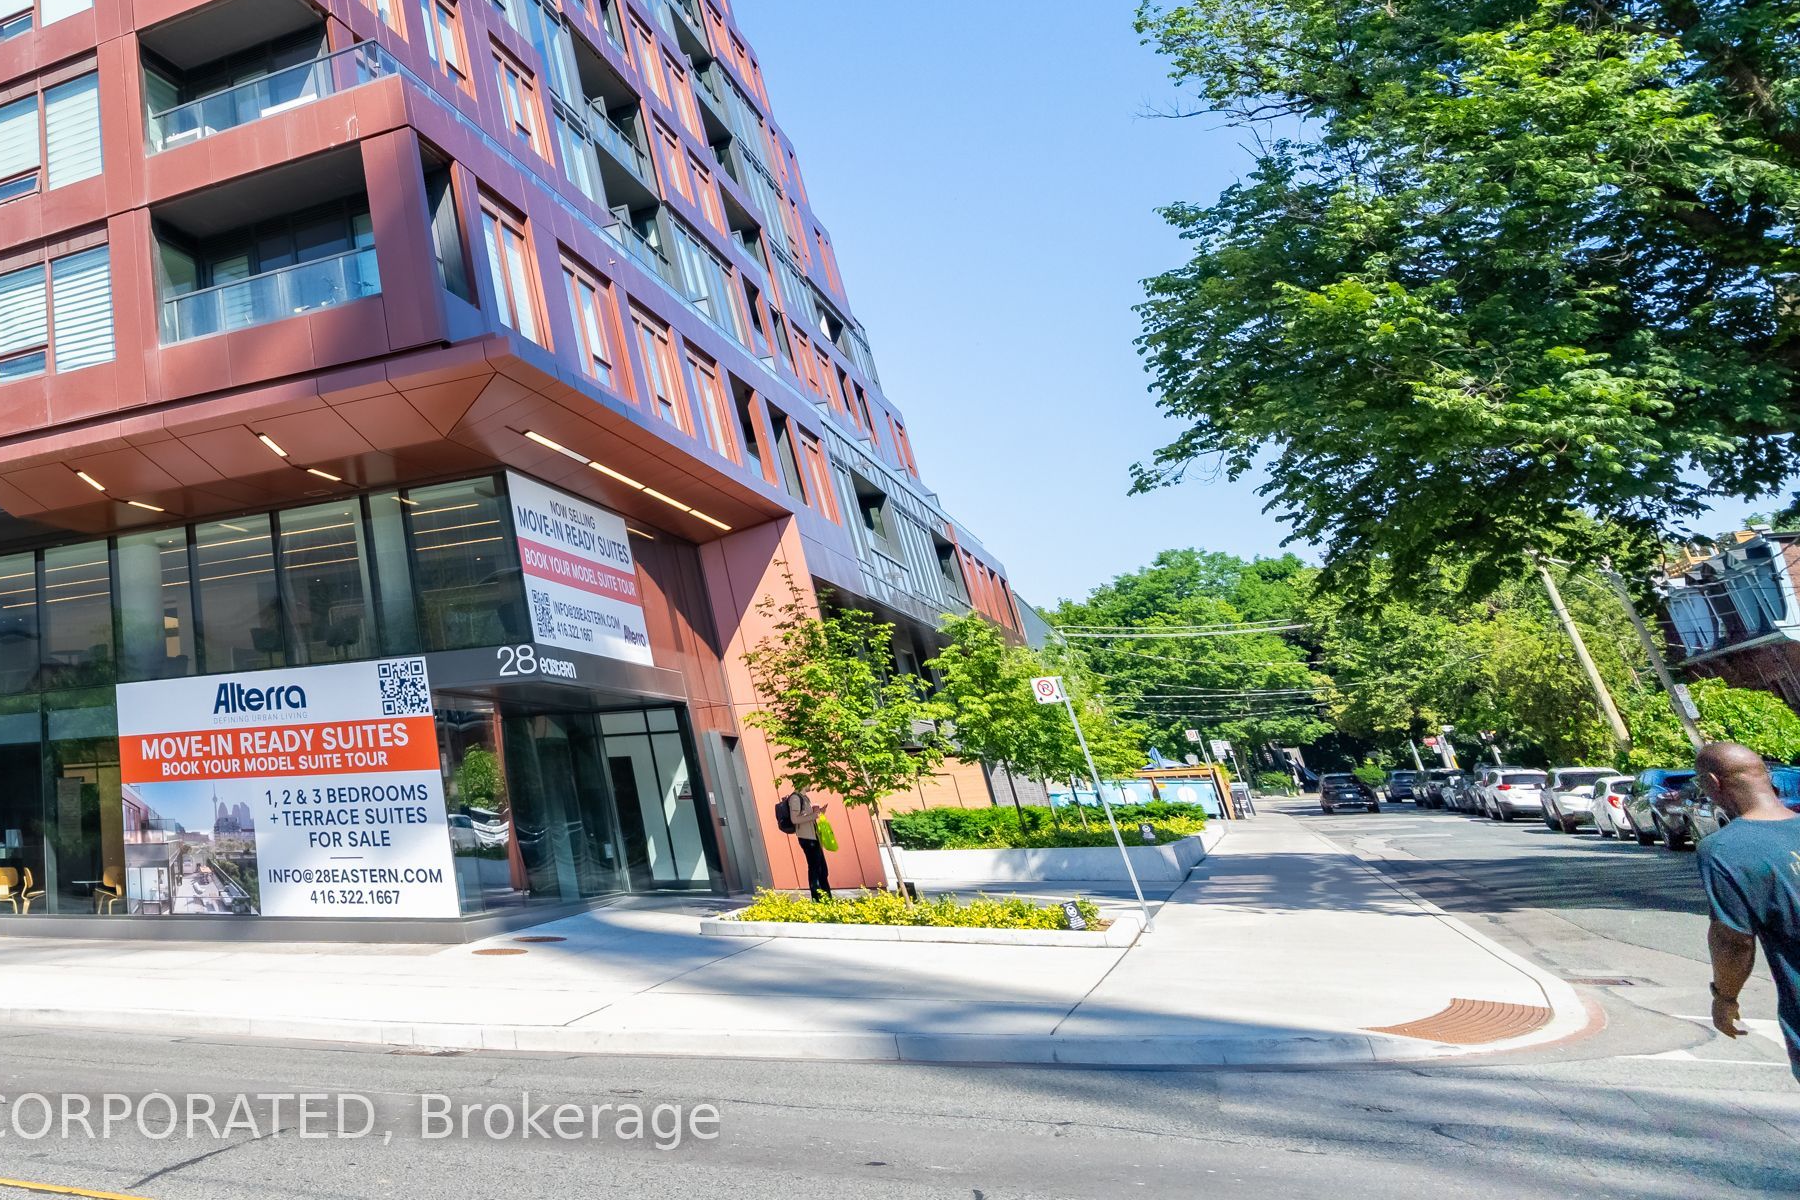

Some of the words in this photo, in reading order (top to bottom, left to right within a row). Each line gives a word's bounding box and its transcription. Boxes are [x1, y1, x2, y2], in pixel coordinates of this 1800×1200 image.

[549, 500, 568, 519] NOW
[568, 507, 596, 530] SELLING
[517, 505, 564, 542] MOVE-IN
[565, 523, 596, 553] READY
[597, 535, 630, 564] SUITES
[524, 547, 549, 571] BOOK
[548, 555, 572, 577] YOUR
[571, 564, 598, 585] MODEL
[597, 571, 618, 592] SUITE
[617, 577, 636, 597] TOUR
[553, 601, 621, 630] INFO@28EASTERN.COM
[556, 621, 594, 643] 416.322.1667
[623, 624, 647, 648] Alterra
[496, 644, 538, 677] 28
[213, 682, 307, 715] Alterra
[213, 715, 250, 725] DEFINING
[251, 712, 278, 722] URBAN
[280, 711, 308, 721] LIVING
[141, 733, 233, 760] MOVE-IN
[239, 728, 314, 755] READY
[321, 722, 409, 751] SUITES
[161, 760, 200, 776] BOOK
[202, 758, 240, 774] YOUR
[243, 755, 296, 772] MODEL
[298, 753, 342, 770] SUITE
[344, 751, 388, 768] TOUR
[265, 789, 278, 808] 1,
[282, 789, 292, 805] 2
[296, 789, 307, 805] &
[312, 788, 322, 804] 3
[326, 784, 428, 803] BEDROOMS
[270, 813, 279, 825] +
[282, 809, 360, 826] TERRACE
[365, 806, 428, 824] SUITES
[309, 831, 343, 848] FOR
[347, 830, 392, 848] SALE
[268, 868, 443, 884] INFO@28EASTERN.COM
[310, 890, 400, 905] 416.322.1667
